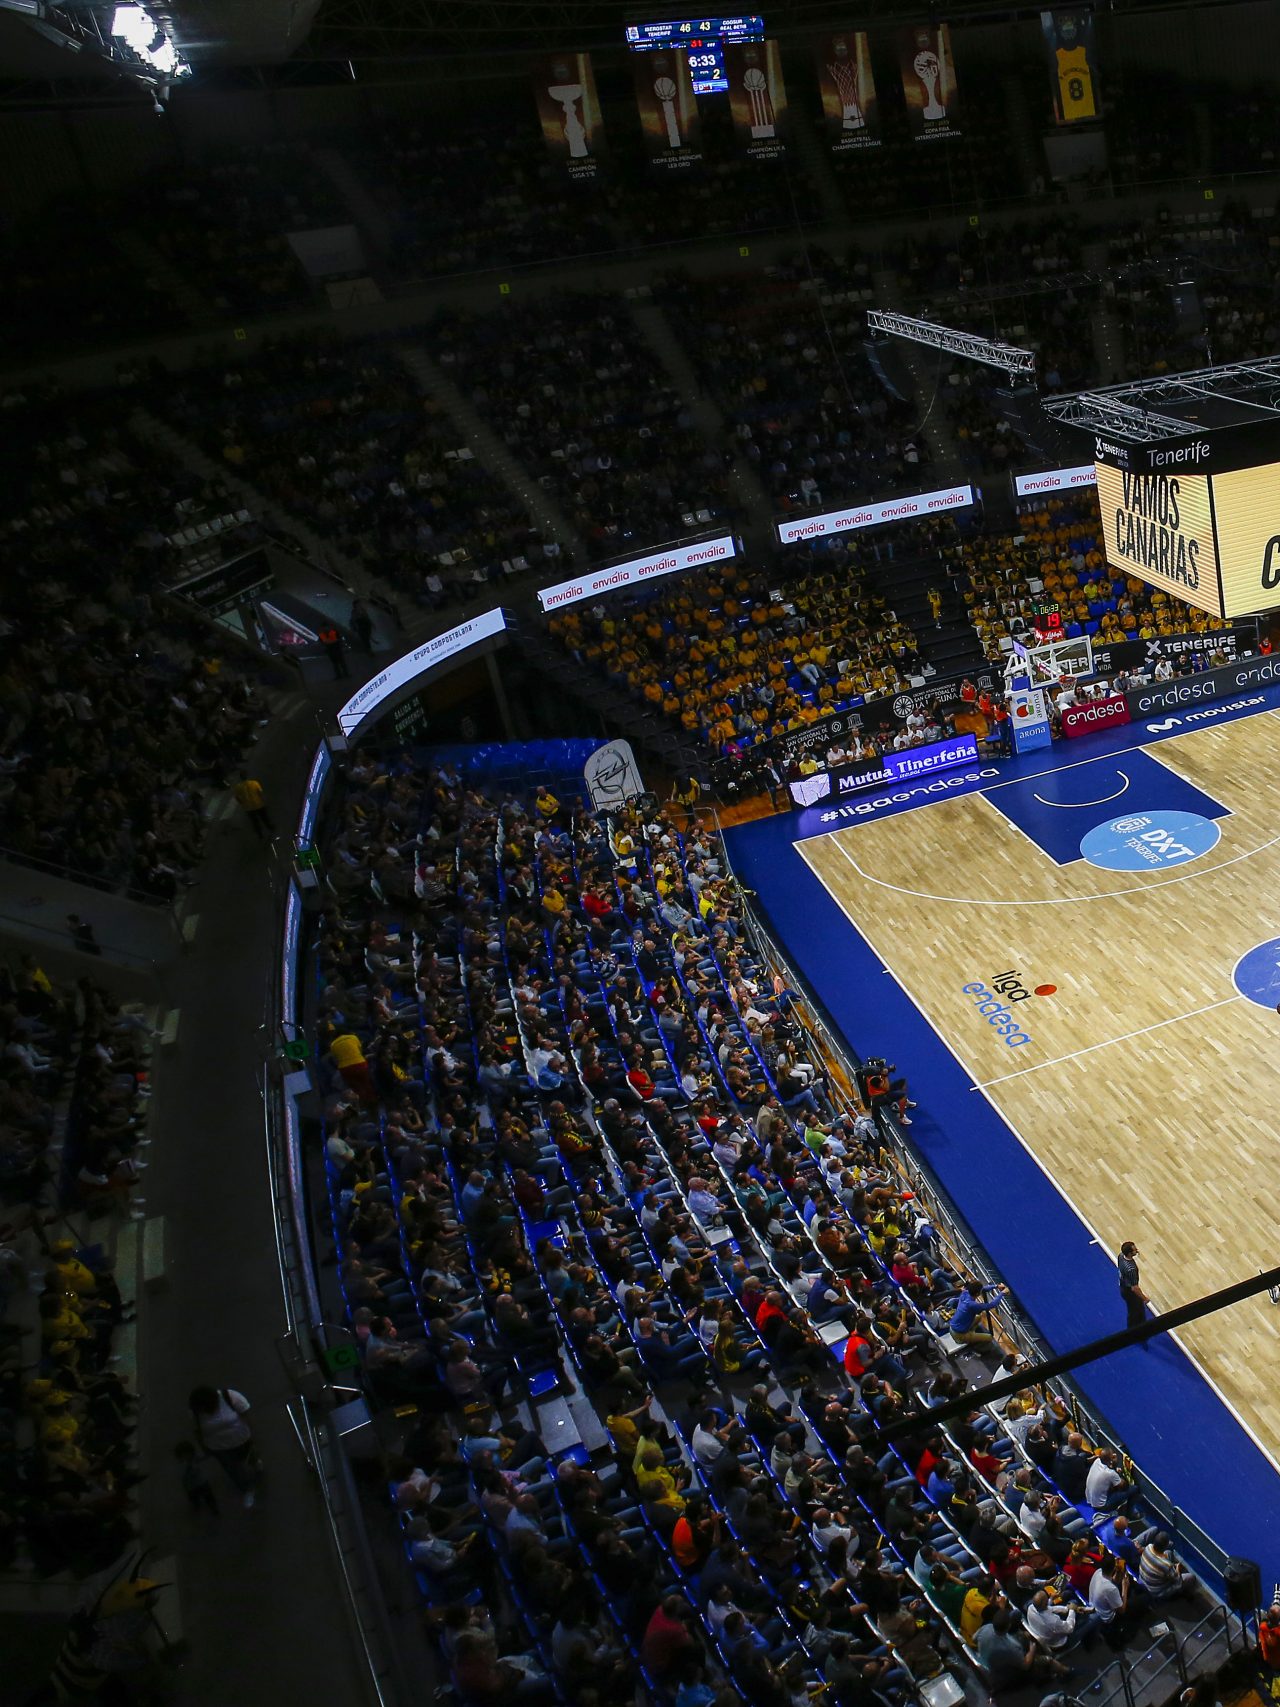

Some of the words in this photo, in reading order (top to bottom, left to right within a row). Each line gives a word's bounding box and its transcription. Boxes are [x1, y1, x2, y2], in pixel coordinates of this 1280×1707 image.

[644, 25, 673, 33] IBEROSTAR
[647, 30, 671, 38] TENERIFE
[680, 23, 691, 33] 46
[699, 22, 711, 31] 43
[712, 68, 720, 80] 2
[1146, 441, 1210, 467] Tenerife
[1070, 469, 1096, 483] enviá
[1121, 470, 1180, 530] VAMOS
[1115, 507, 1200, 591] CANARIAS
[1040, 603, 1059, 615] 06:33
[1047, 612, 1060, 627] 19
[1164, 635, 1236, 653] TENERIFE
[1138, 681, 1217, 712] endesa
[1185, 695, 1266, 722] movistar
[1066, 700, 1125, 726] endesa
[839, 767, 894, 790] Mutua
[897, 745, 977, 774] Tinerfeña
[820, 767, 1001, 823] #ligaendesa
[1125, 837, 1163, 864] TENERIFE
[1140, 828, 1196, 860] DXT
[991, 969, 1032, 1003] liga
[962, 981, 1032, 1048] endesa
